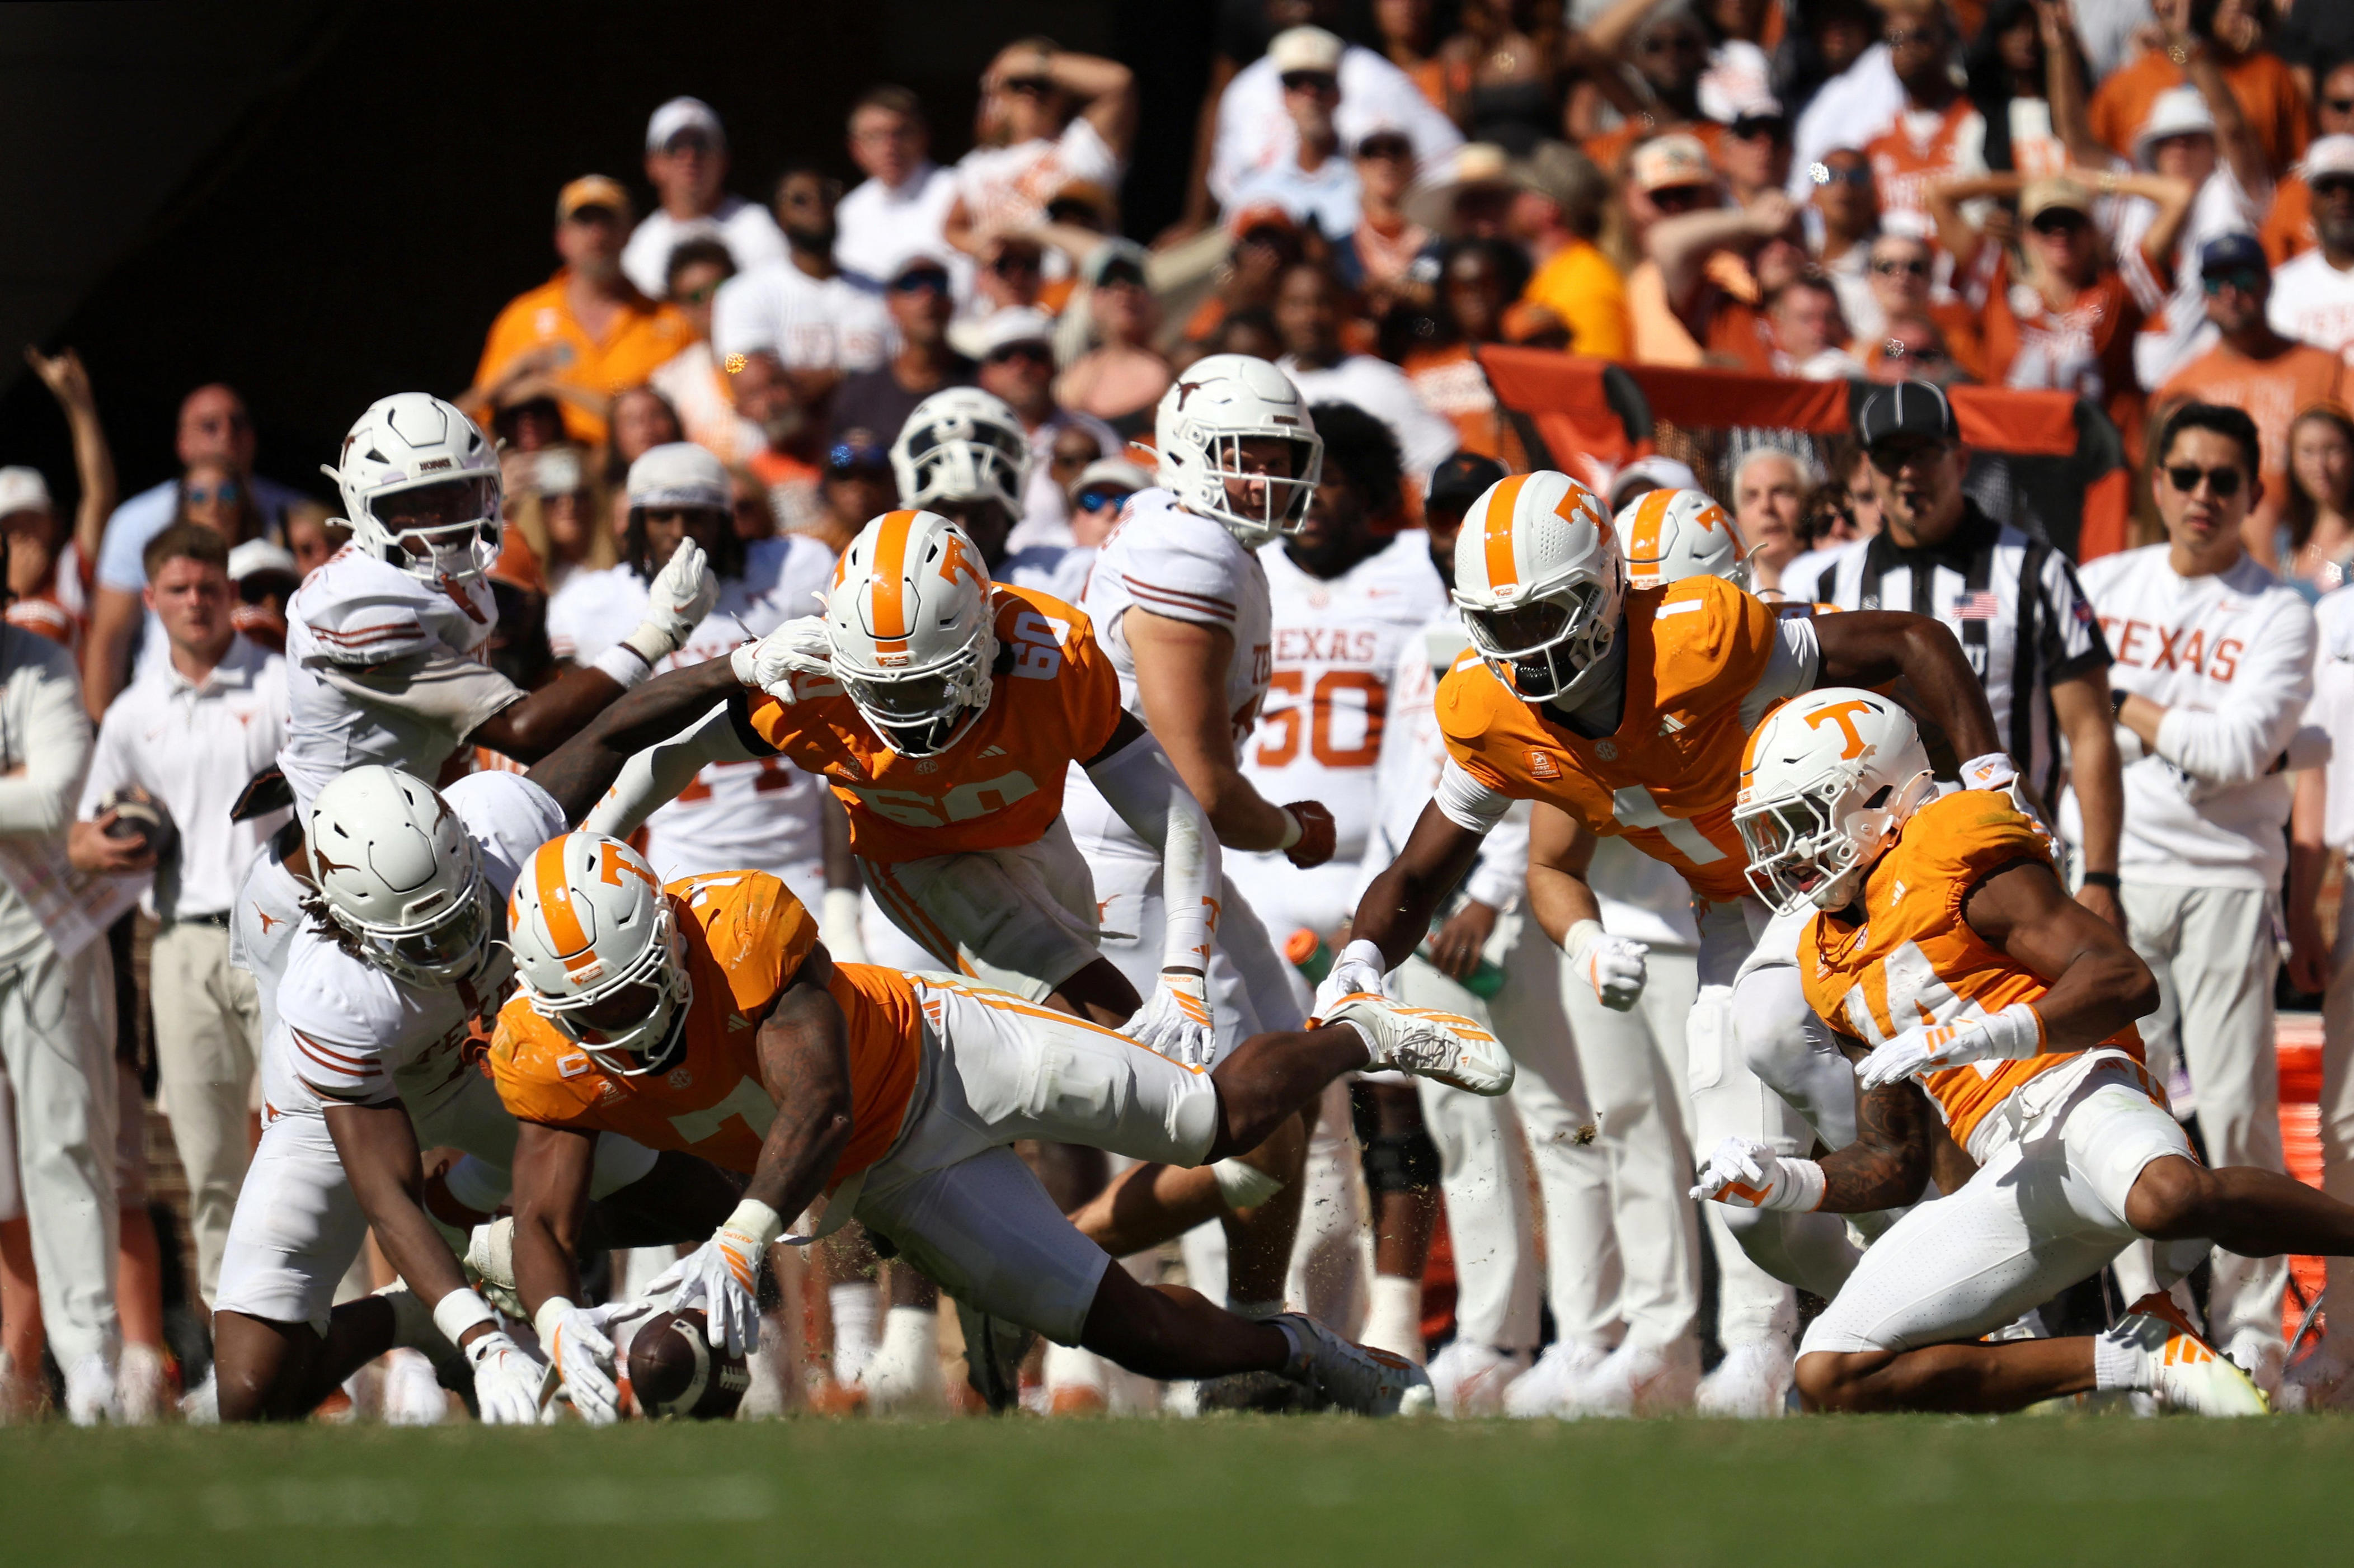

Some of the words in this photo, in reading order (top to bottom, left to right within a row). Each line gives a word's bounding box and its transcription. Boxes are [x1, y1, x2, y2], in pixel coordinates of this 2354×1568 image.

[1273, 627, 1377, 662] EXAS
[1256, 671, 1387, 767] 50
[415, 975, 515, 1065] TEXA
